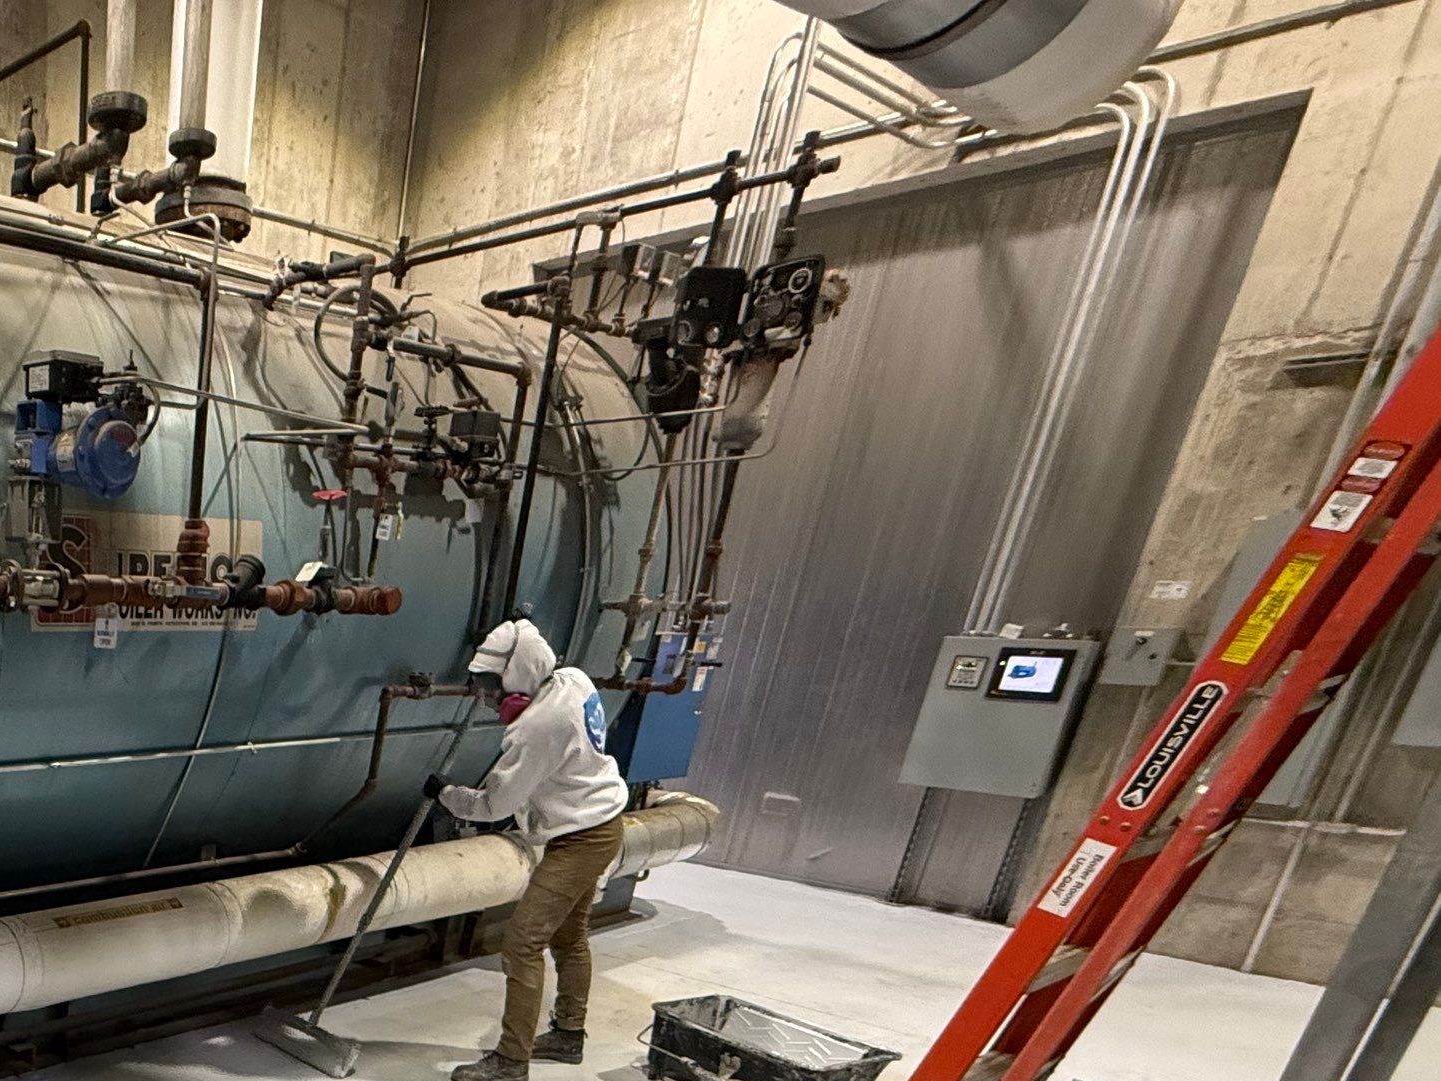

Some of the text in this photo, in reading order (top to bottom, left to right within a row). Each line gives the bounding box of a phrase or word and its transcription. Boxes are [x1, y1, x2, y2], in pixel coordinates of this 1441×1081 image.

[1137, 685, 1219, 789] LOUISVILLE
[1059, 853, 1104, 907] Boiler Room
